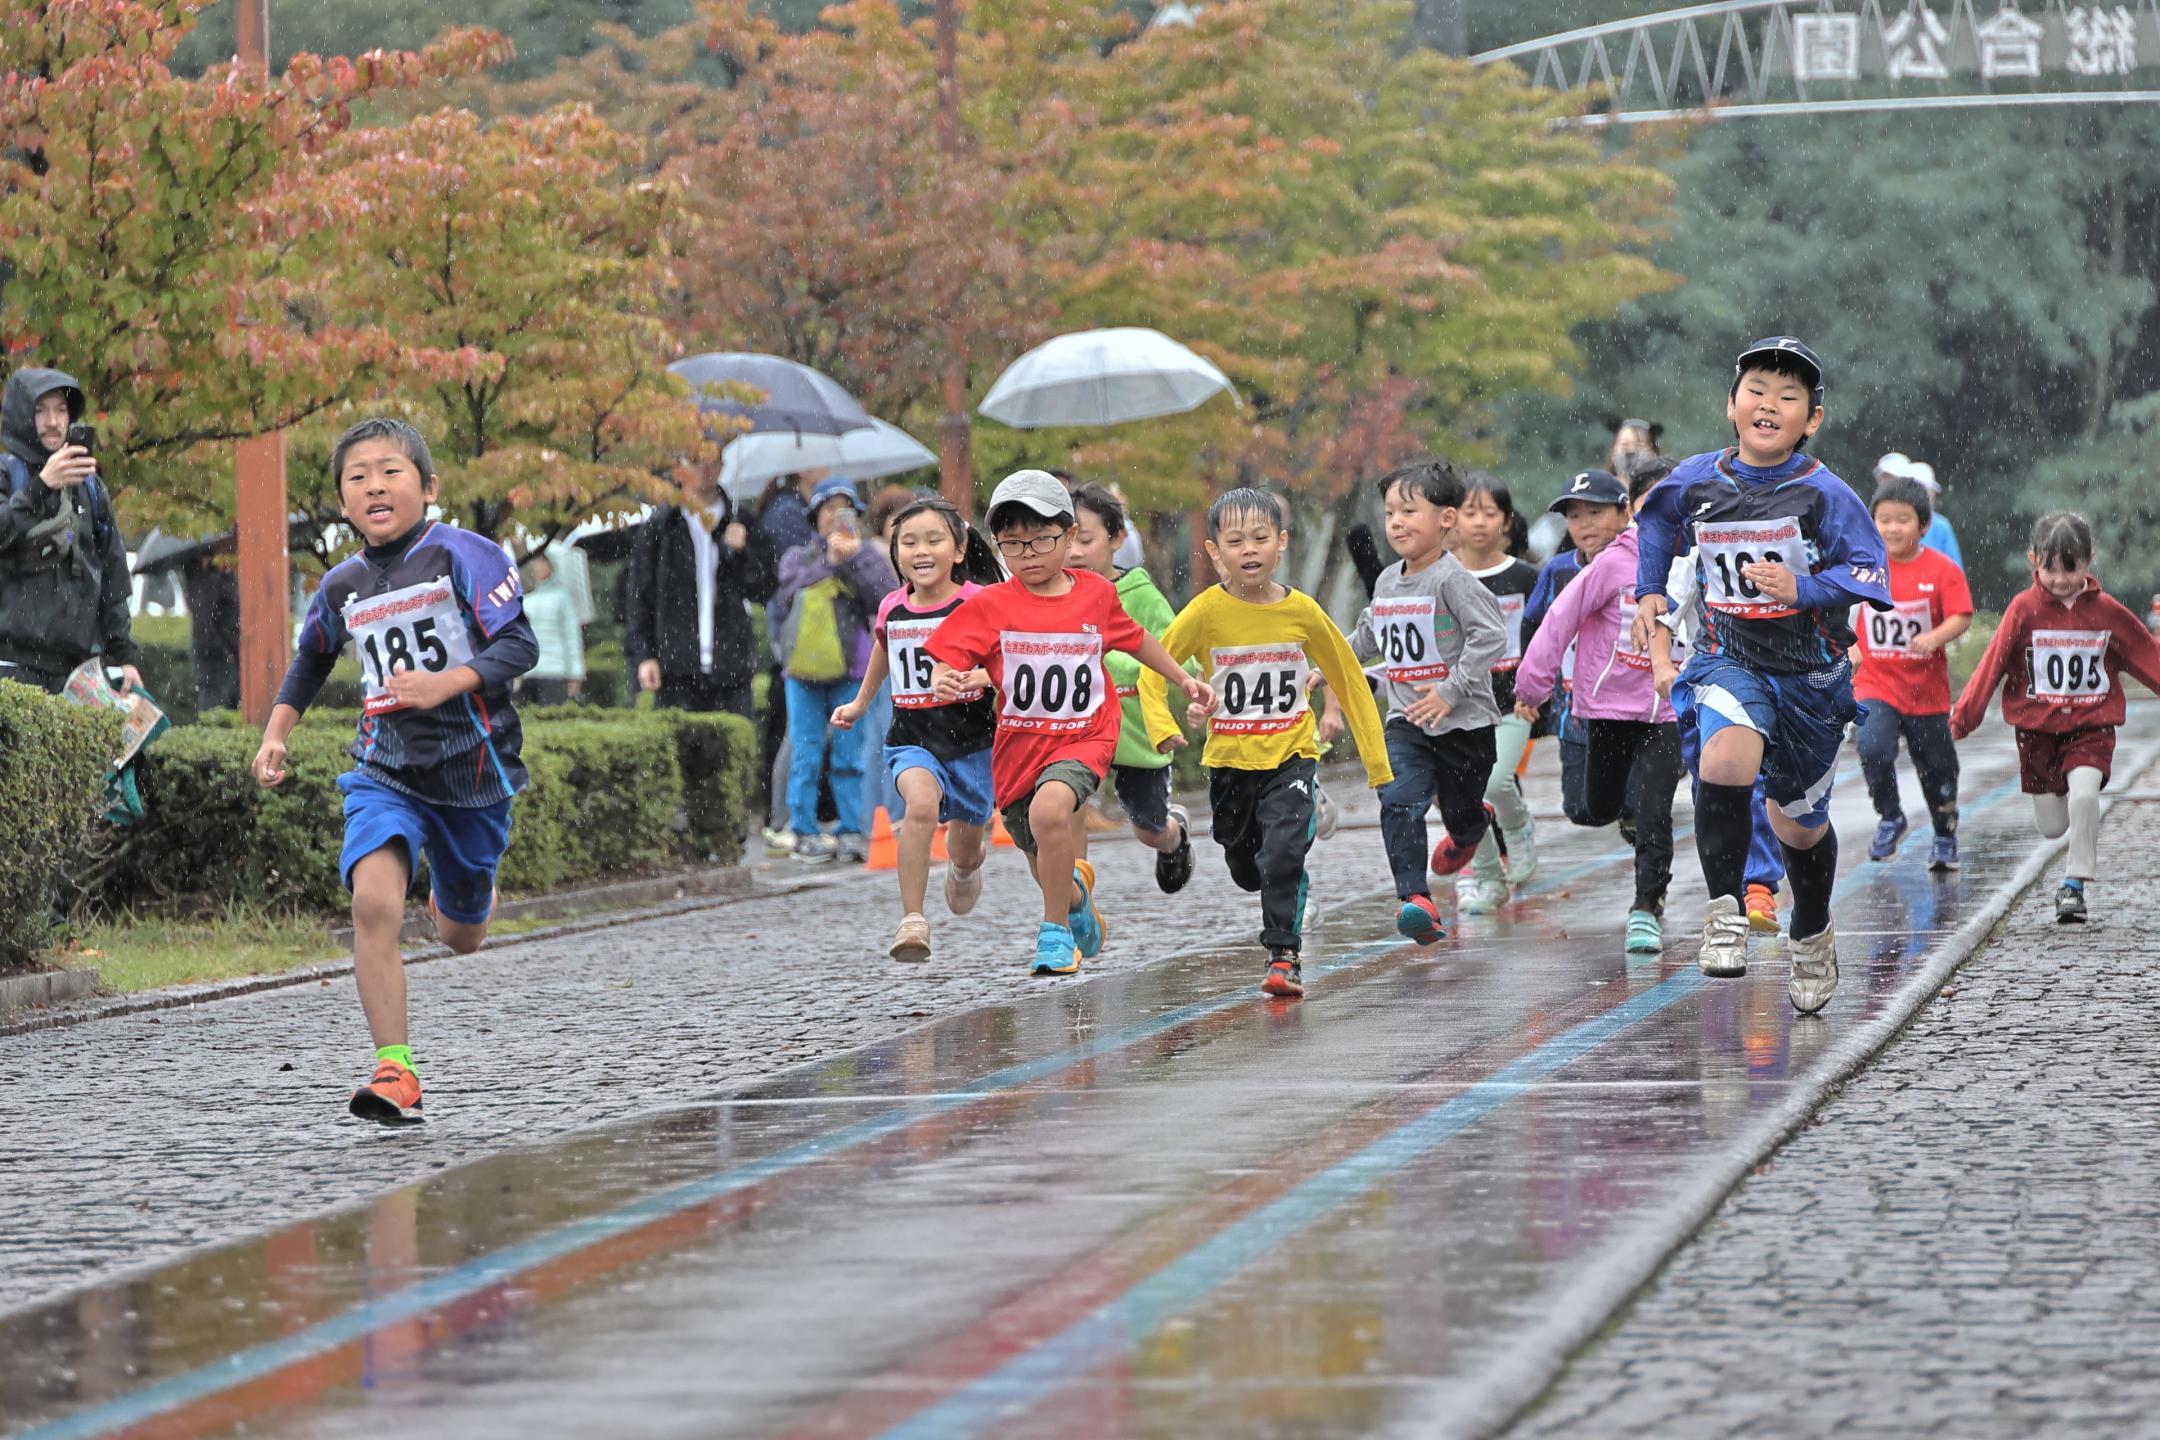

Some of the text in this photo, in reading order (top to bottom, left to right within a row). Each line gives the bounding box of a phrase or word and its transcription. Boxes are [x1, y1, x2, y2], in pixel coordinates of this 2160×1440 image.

[1759, 604, 1789, 614] SPO
[364, 617, 447, 688] 185
[1380, 622, 1424, 663] 160
[899, 647, 933, 689] 15
[1404, 666, 1445, 677] SPORTS
[2047, 654, 2101, 690] 095
[367, 697, 397, 709] ENJO
[1013, 664, 1091, 712] 008
[1224, 670, 1296, 714] 045
[1001, 718, 1044, 728] ENJOY
[1214, 722, 1255, 730] ENJOY
